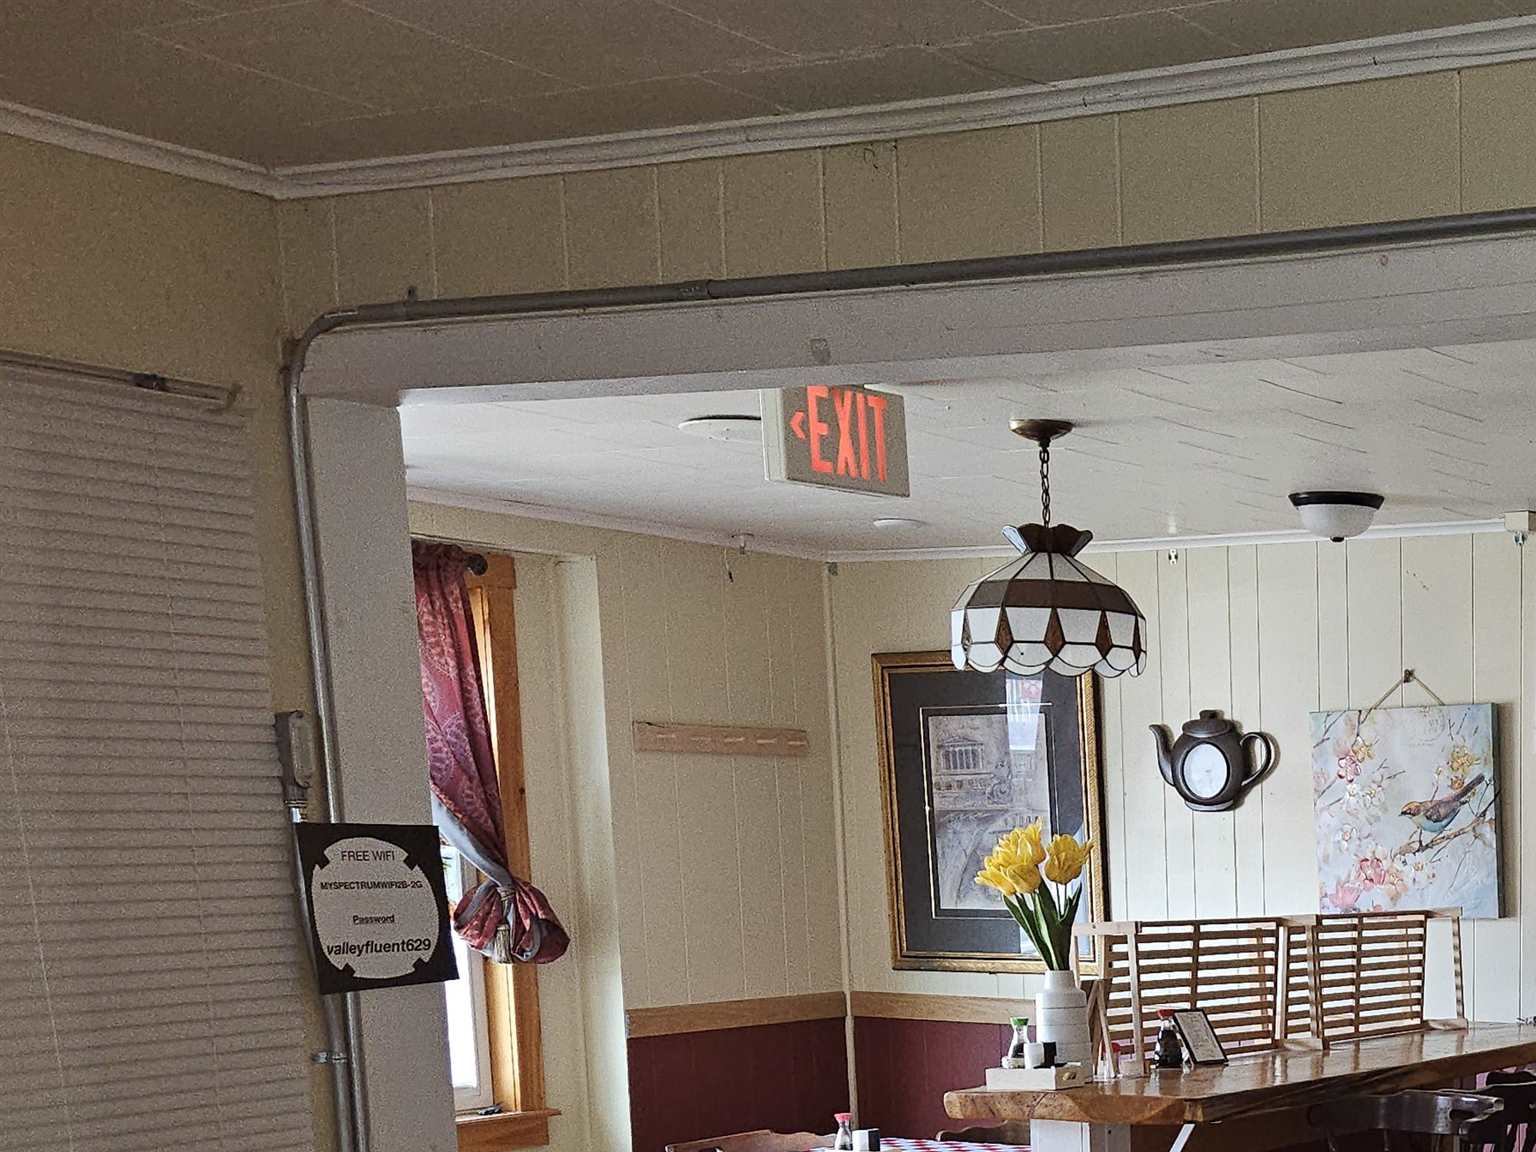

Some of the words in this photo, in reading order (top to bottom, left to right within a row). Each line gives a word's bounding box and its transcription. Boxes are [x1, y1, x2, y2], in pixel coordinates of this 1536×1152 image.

[806, 385, 887, 481] EXIT
[340, 850, 370, 862] FREE
[371, 850, 396, 861] WIFI
[352, 914, 396, 926] Password
[326, 938, 432, 957] valleyfluent629
